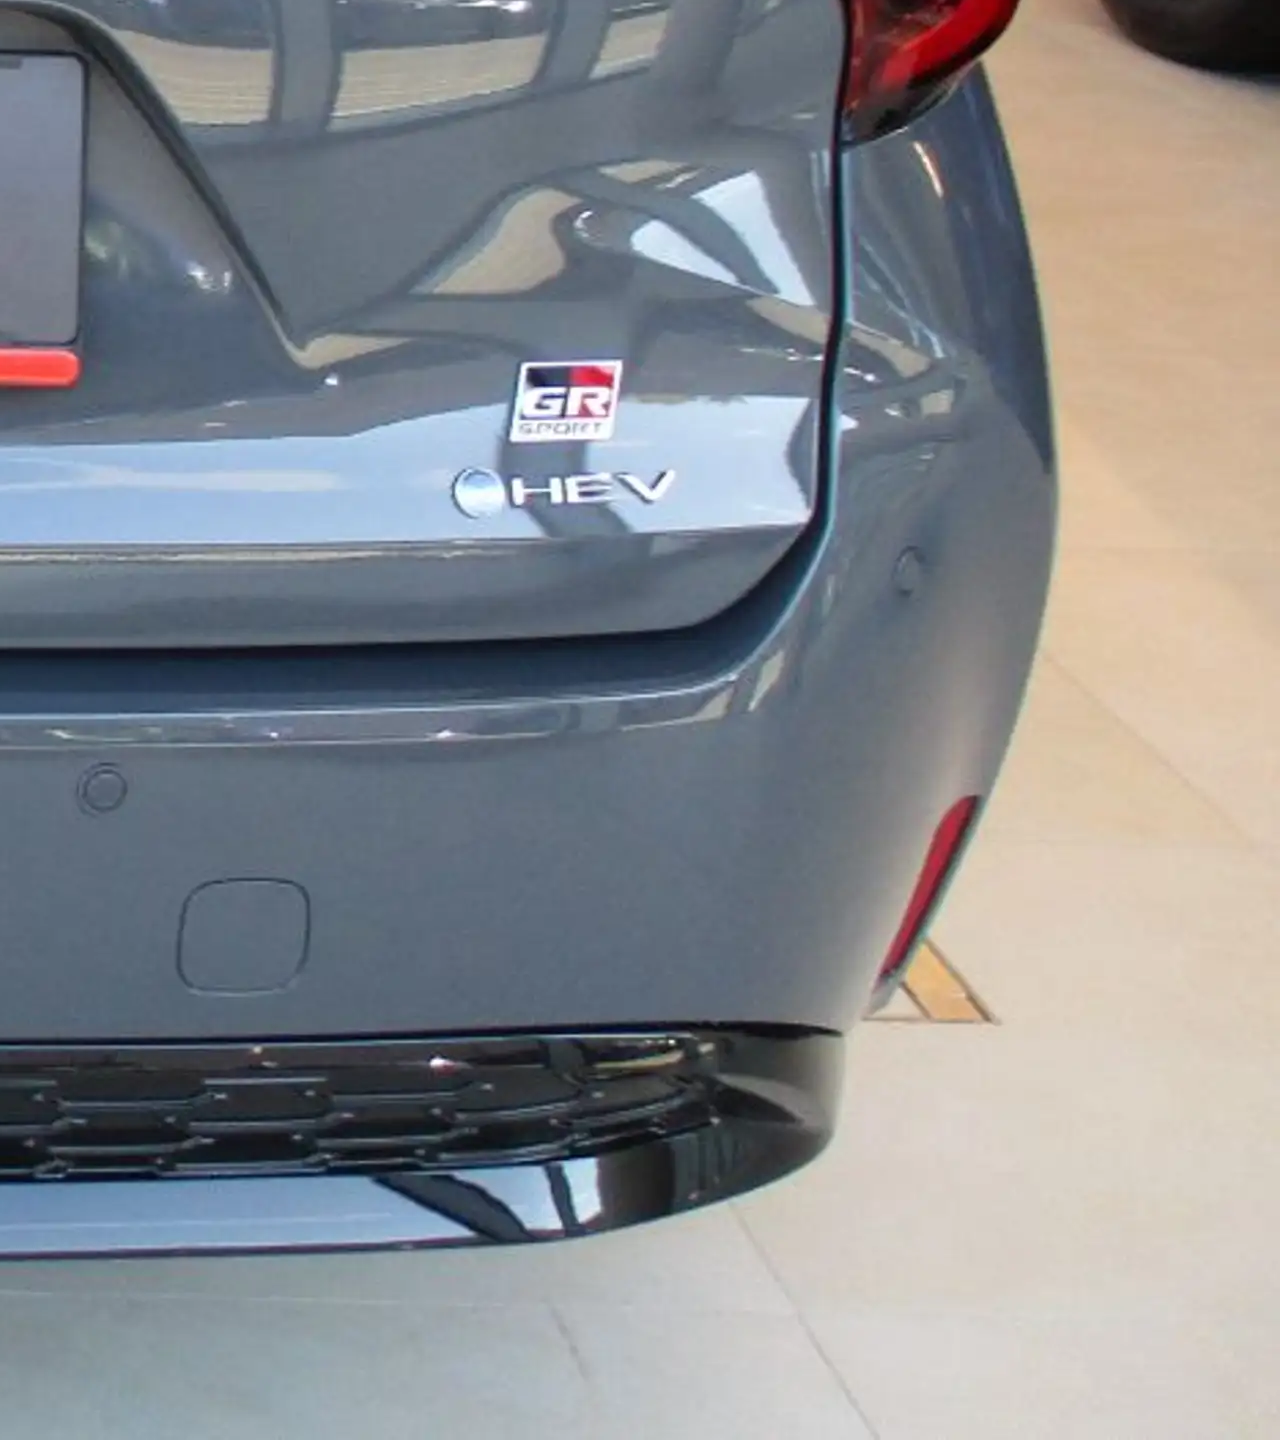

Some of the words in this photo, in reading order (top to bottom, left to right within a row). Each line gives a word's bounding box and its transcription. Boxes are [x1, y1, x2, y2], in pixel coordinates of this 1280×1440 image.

[522, 386, 612, 418] GR
[518, 421, 604, 436] SPORT
[510, 468, 676, 506] HEV
